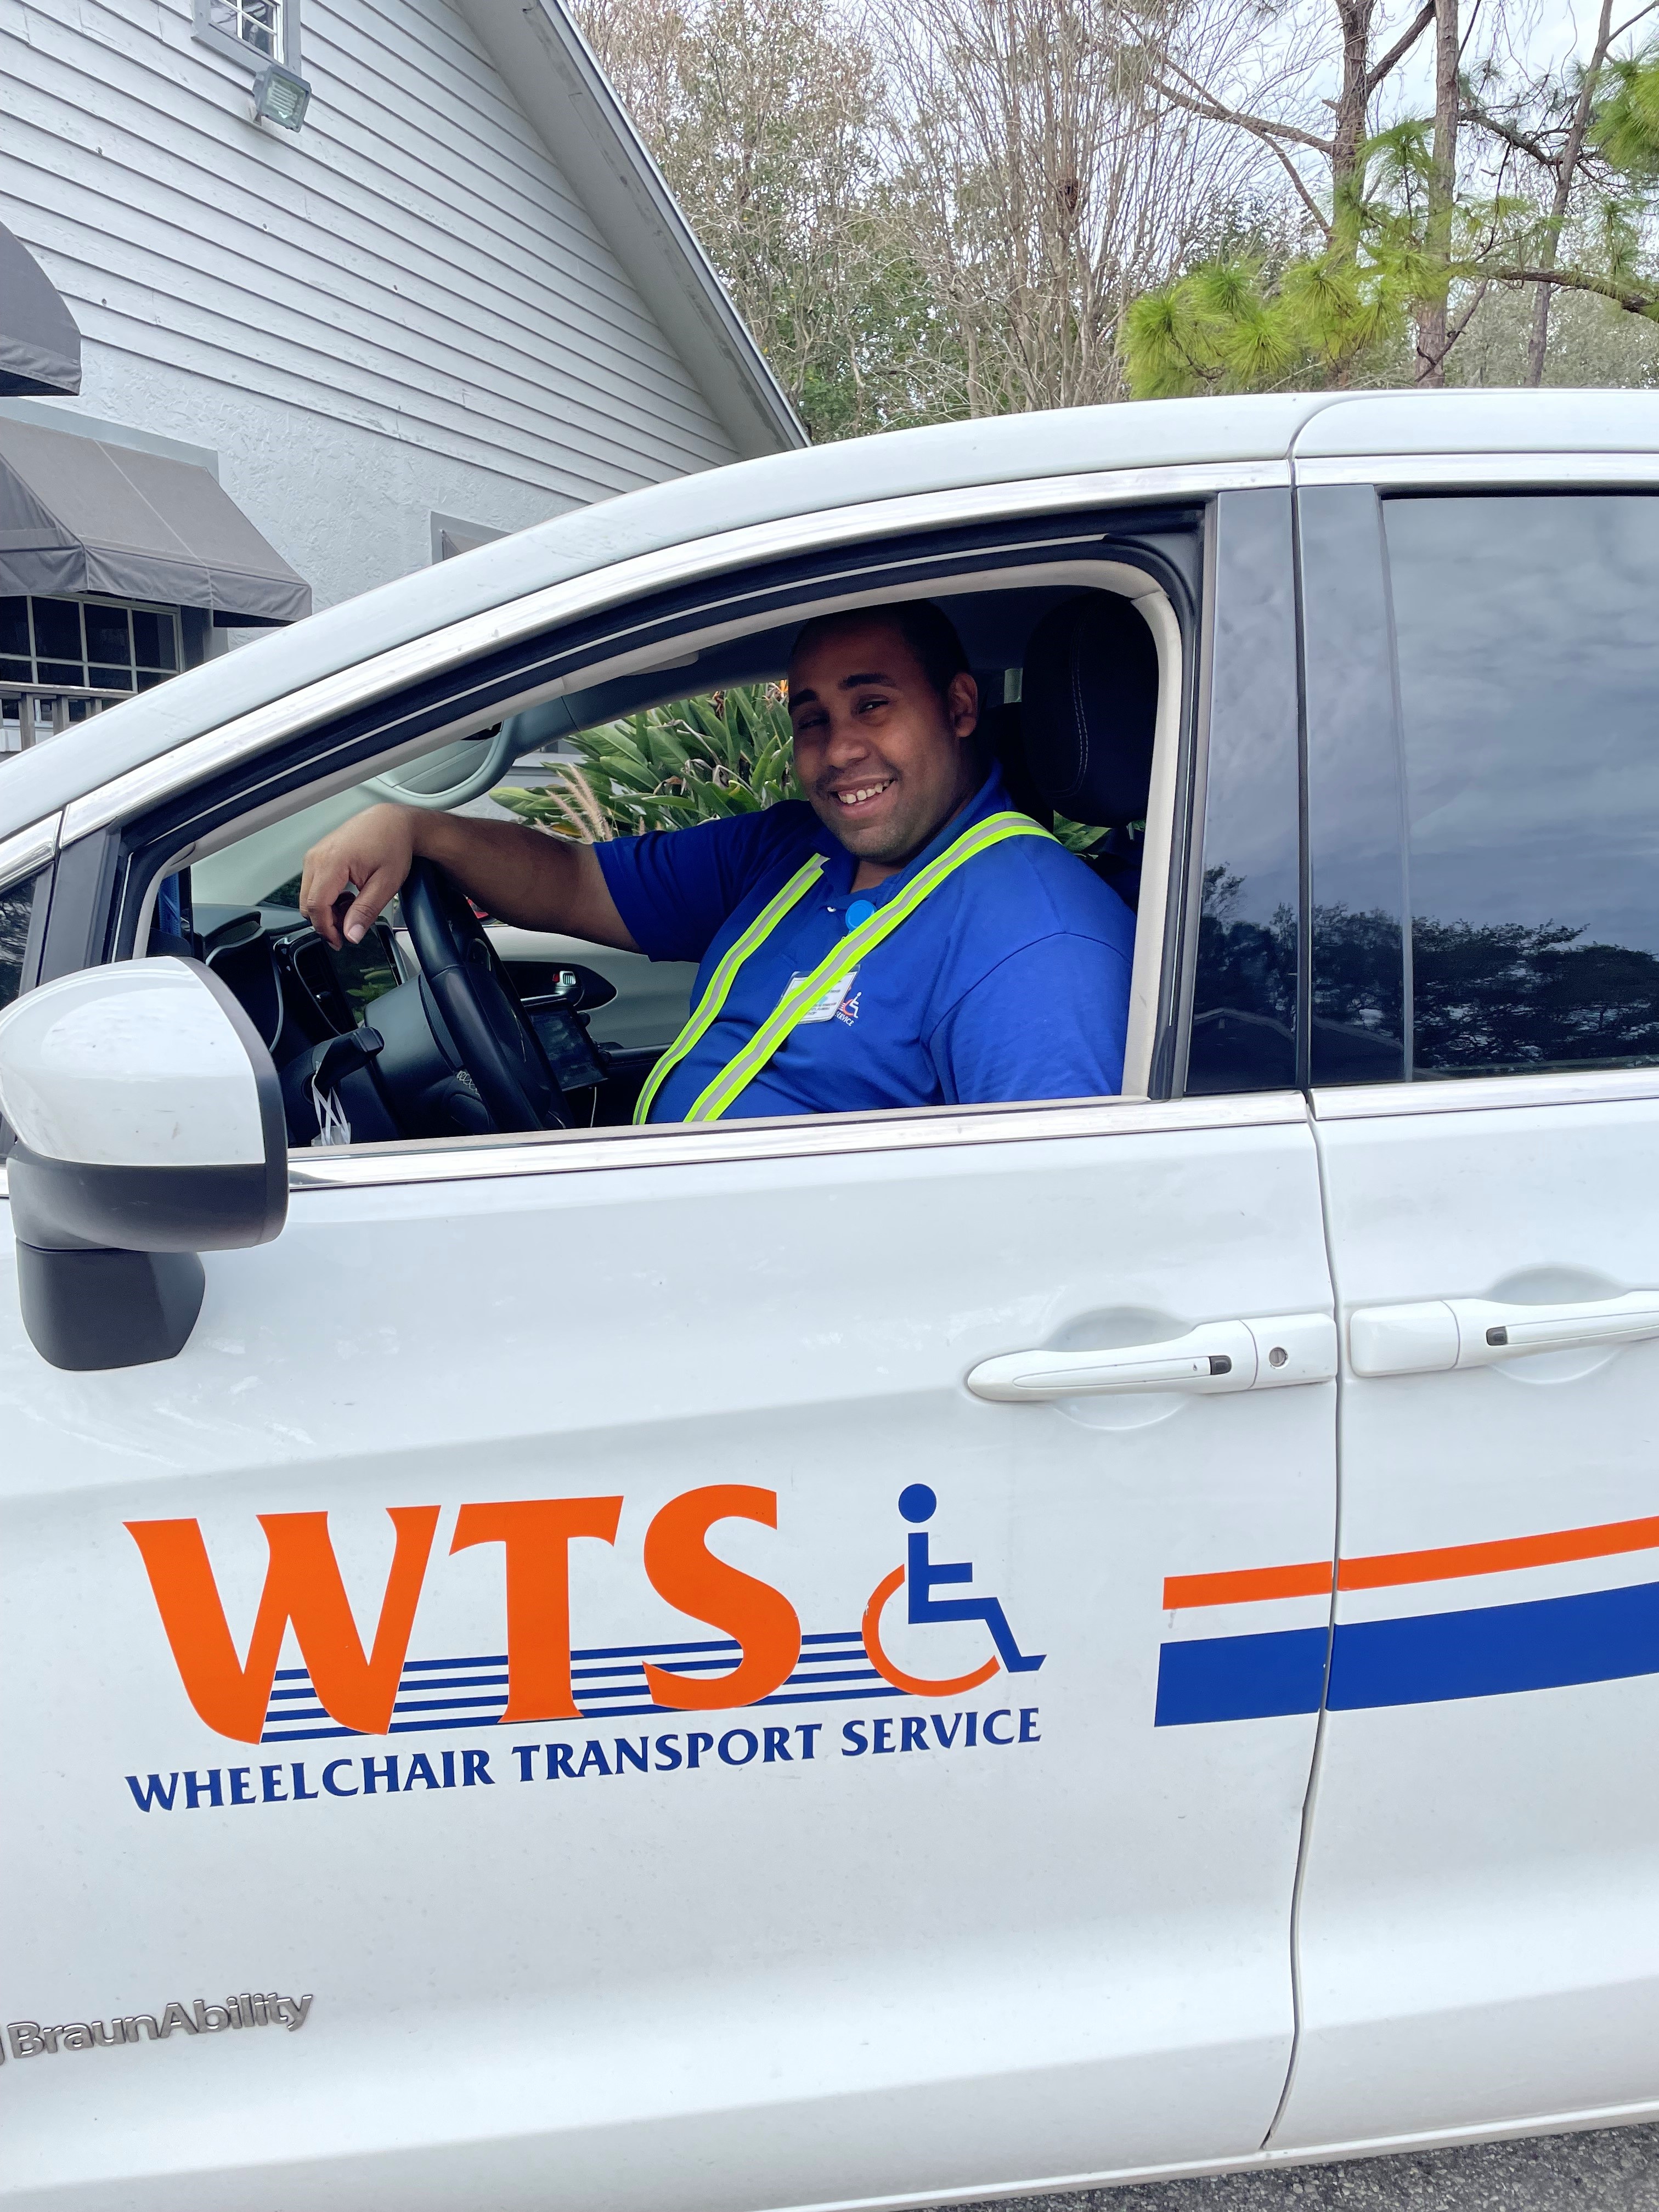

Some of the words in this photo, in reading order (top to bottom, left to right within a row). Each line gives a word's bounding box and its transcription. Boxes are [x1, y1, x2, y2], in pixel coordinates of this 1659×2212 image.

[122, 1483, 802, 1745] WTS
[125, 1749, 494, 1813] WHEELCHAIR
[511, 1723, 822, 1782] TRANSPORT
[841, 1707, 1041, 1757] SERVICE
[7, 1992, 313, 2059] BraunAbility
